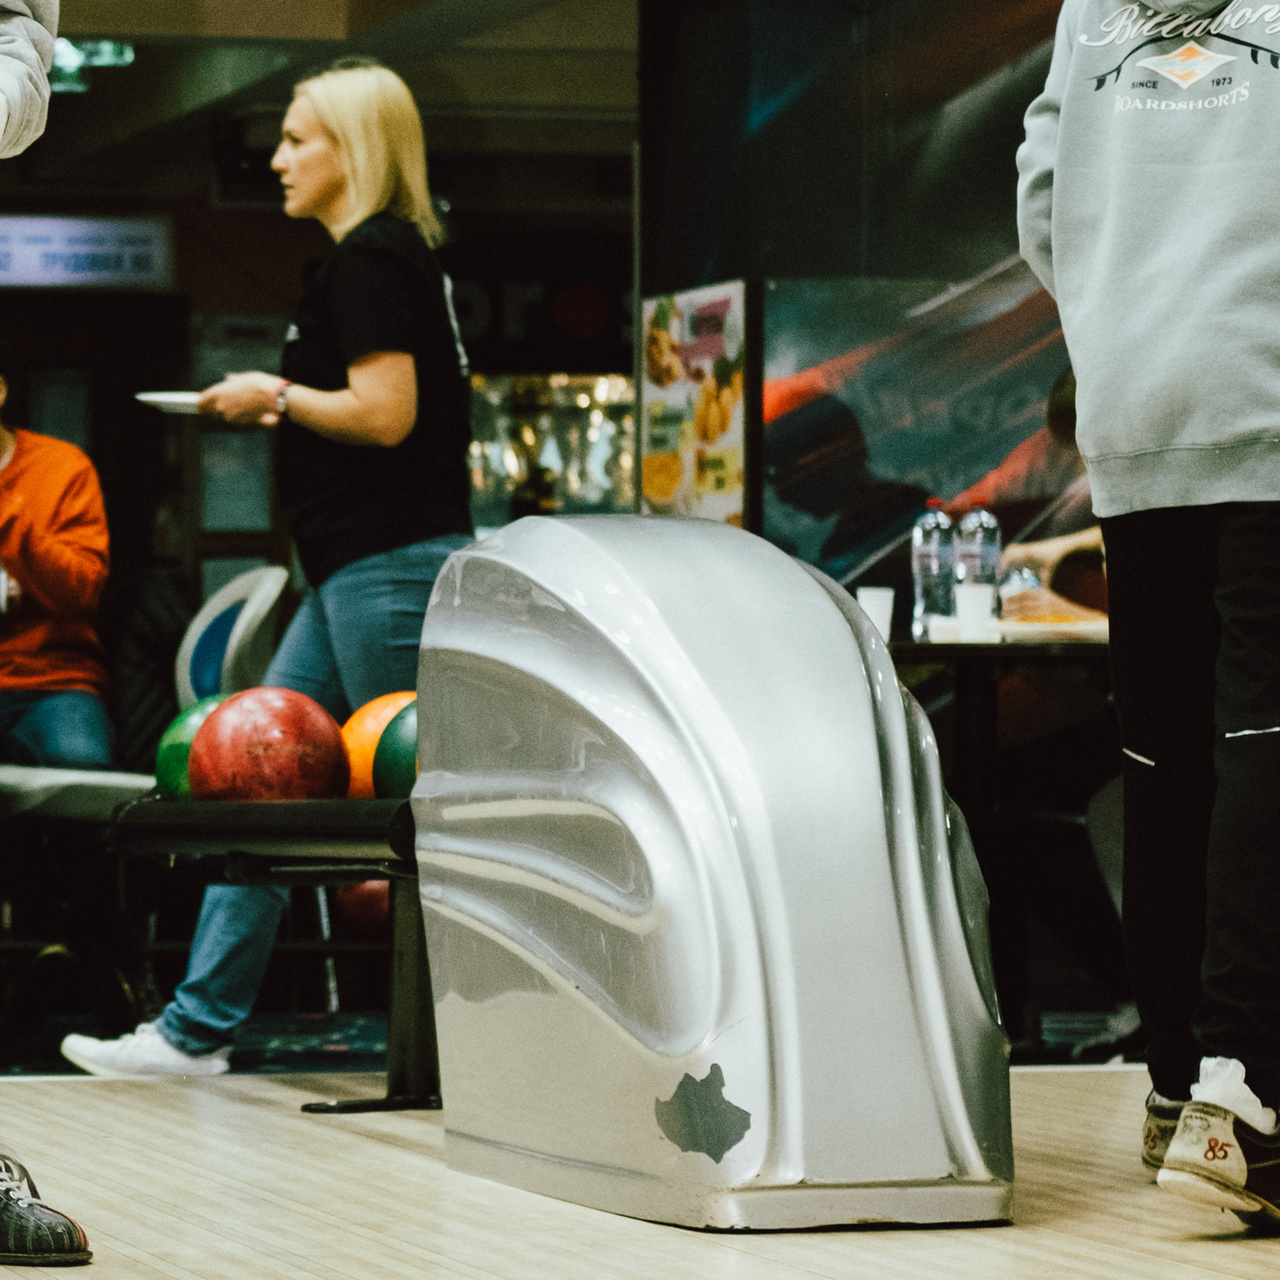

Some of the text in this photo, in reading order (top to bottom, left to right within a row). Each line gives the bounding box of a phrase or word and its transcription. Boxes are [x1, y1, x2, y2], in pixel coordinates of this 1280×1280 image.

[1131, 77, 1233, 89] SINCE 1973
[1204, 1136, 1237, 1161] 85
